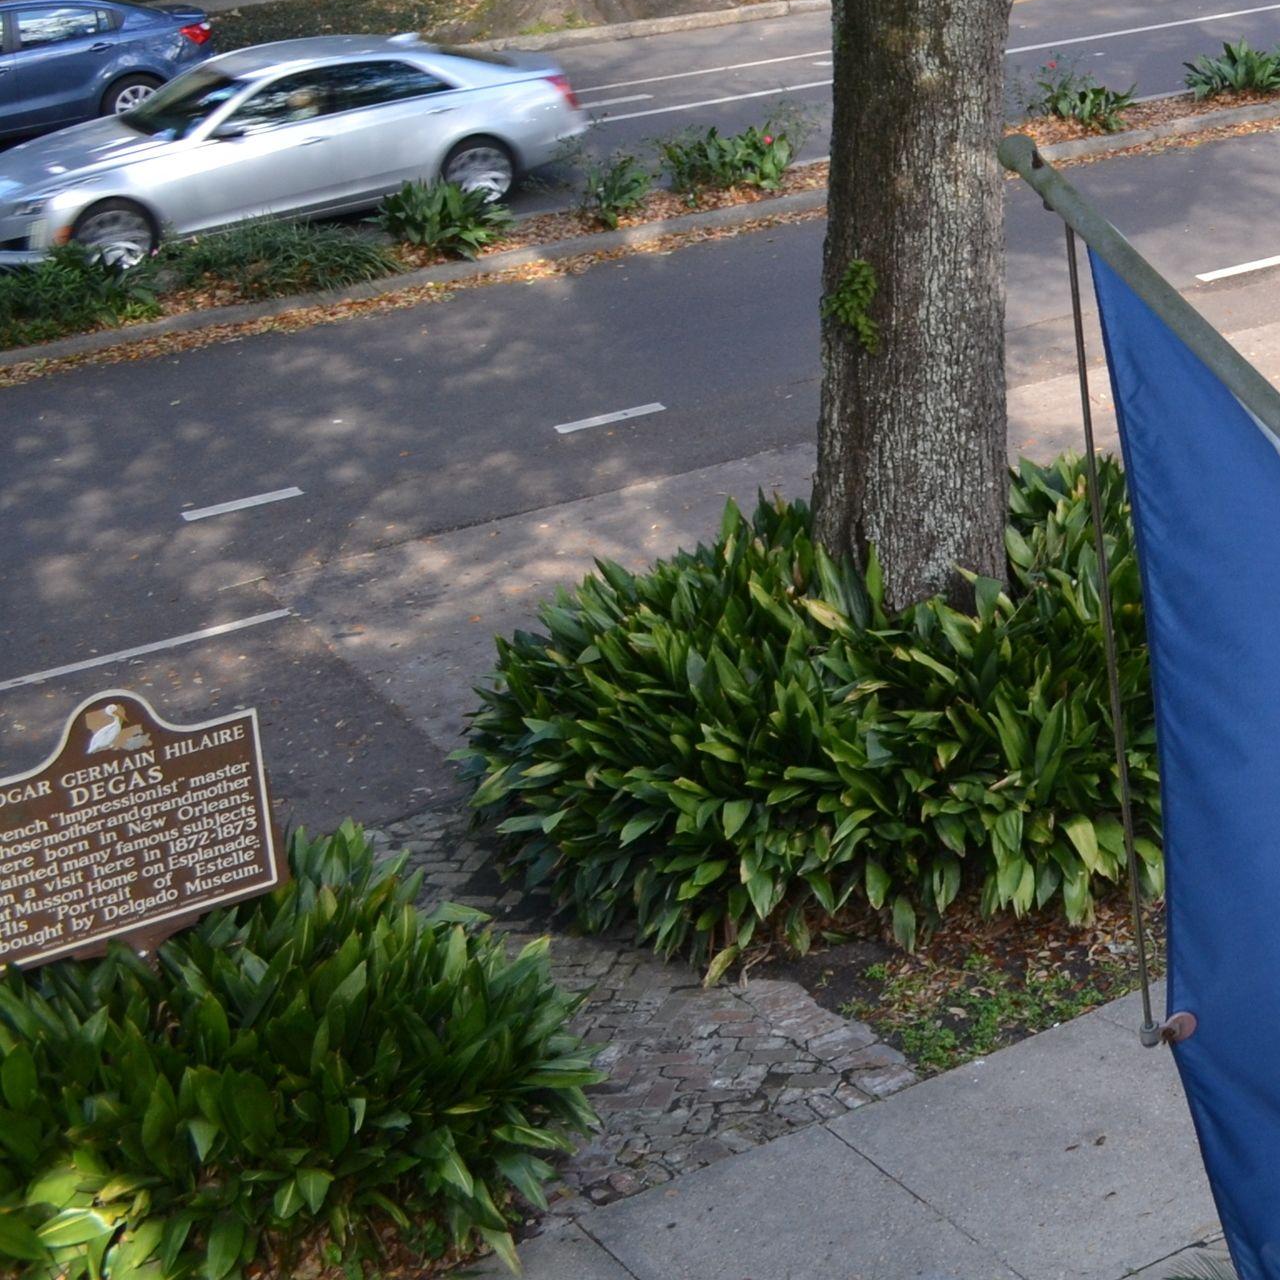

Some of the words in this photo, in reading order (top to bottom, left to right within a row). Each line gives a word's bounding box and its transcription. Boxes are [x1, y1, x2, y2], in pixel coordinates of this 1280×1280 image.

[61, 750, 154, 787] GERMAIN
[164, 725, 244, 759] HILAIRE
[70, 766, 163, 807] DEGAS
[0, 839, 42, 859] hose
[43, 819, 108, 846] mother
[107, 806, 139, 827] and
[140, 776, 251, 820] grandmother
[50, 777, 184, 826] "Impressionist"
[190, 762, 249, 787] master
[0, 856, 34, 874] ere
[44, 840, 89, 862] born
[100, 832, 117, 845] in
[128, 817, 166, 836] New
[177, 792, 254, 820] Orleans.
[0, 862, 58, 890] ainted
[62, 848, 111, 874] many
[115, 828, 178, 855] famous
[183, 805, 256, 841] subjects
[24, 888, 35, 899] a
[44, 871, 83, 891] visit
[92, 857, 134, 878] here
[143, 849, 160, 862] in
[169, 816, 257, 854] 1872-1873
[15, 889, 84, 917] Musson
[87, 871, 137, 895] Home
[142, 863, 164, 877] on
[168, 835, 259, 870] Esplanade.
[48, 886, 130, 920] "Portrait
[153, 872, 172, 889] of
[71, 915, 94, 931] by
[103, 889, 178, 920] Delgado
[185, 864, 263, 895] Museum.
